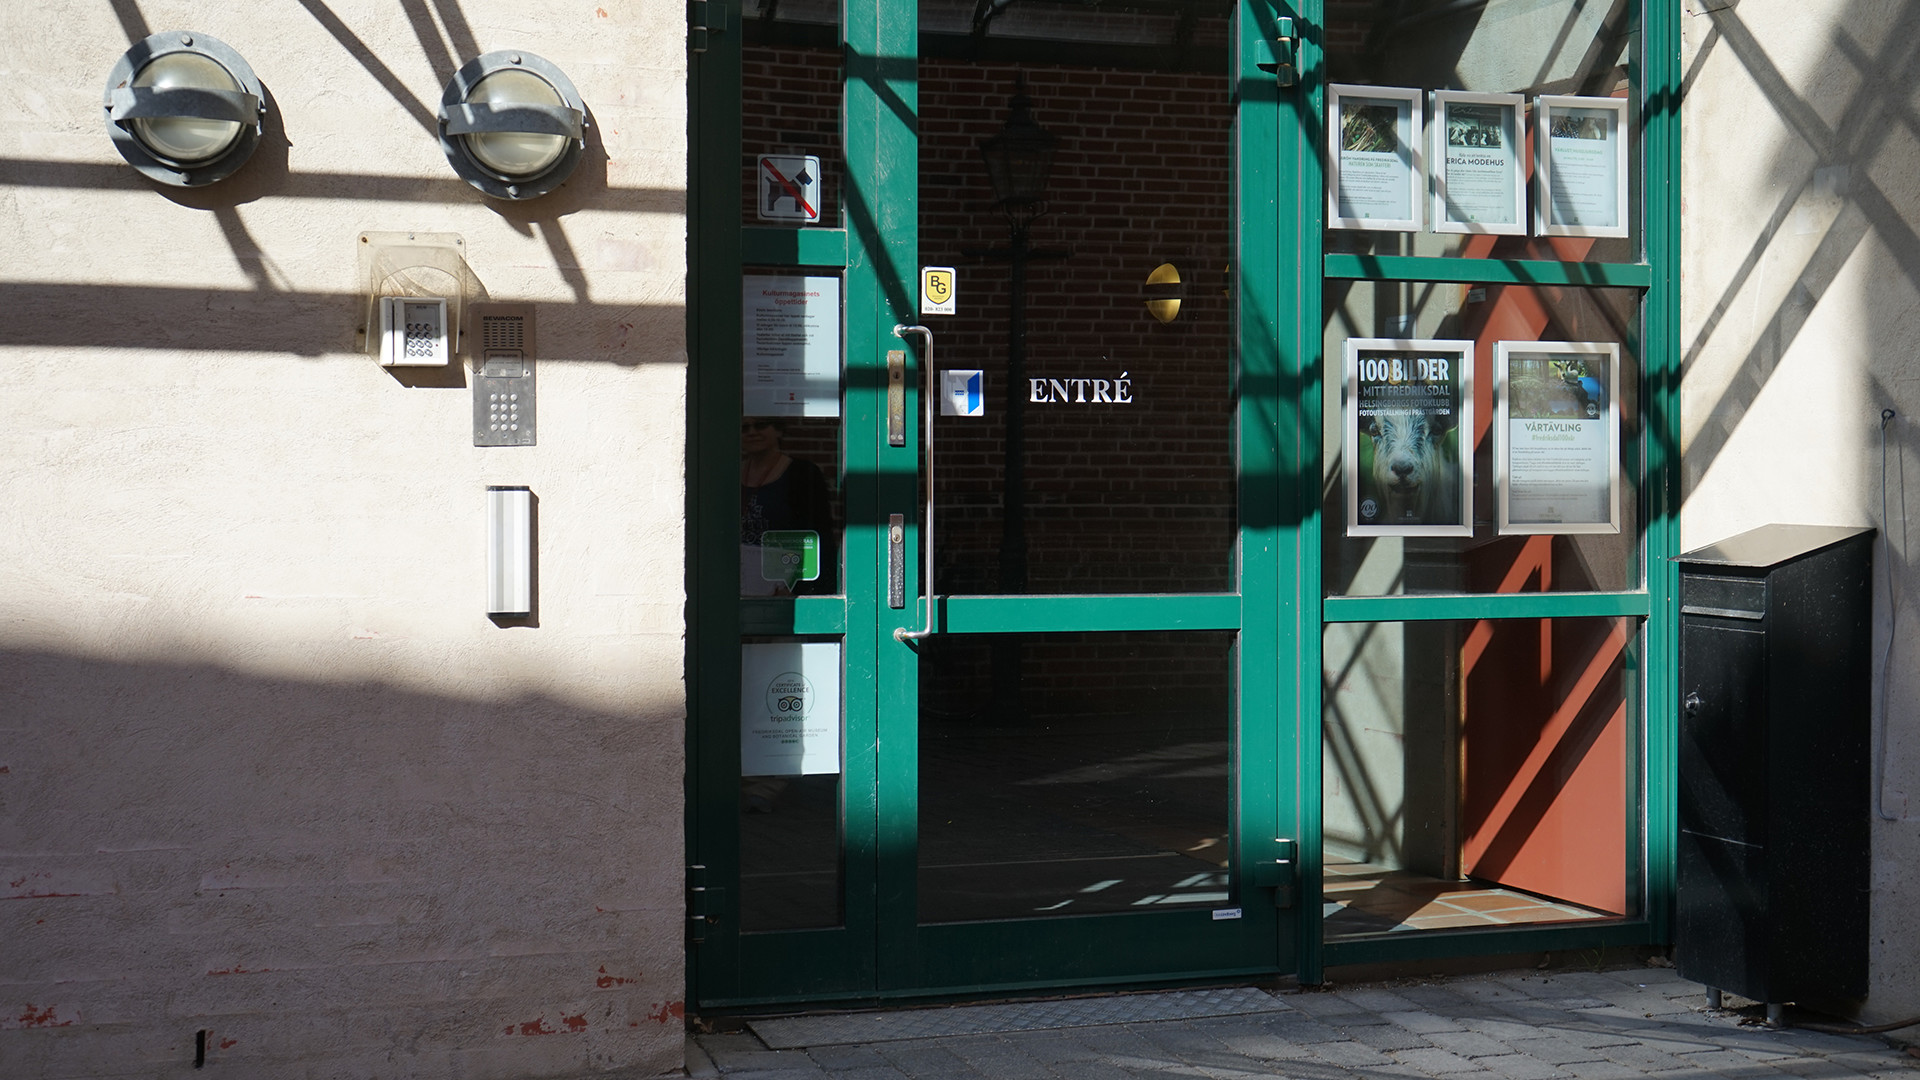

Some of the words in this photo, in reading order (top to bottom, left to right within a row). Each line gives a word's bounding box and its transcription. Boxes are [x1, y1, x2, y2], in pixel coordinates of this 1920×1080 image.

[1447, 157, 1467, 165] ERICA
[1468, 158, 1504, 166] MODEHUS
[931, 275, 946, 294] BG
[762, 290, 820, 298] Kulturmagasinets
[774, 298, 808, 306] öppettider
[1359, 358, 1389, 381] 100
[1392, 358, 1449, 381] BILDER
[1029, 371, 1133, 404] ENTRÉ
[1363, 386, 1386, 396] MITT
[1387, 385, 1450, 396] FREDRIKSDAL
[1359, 399, 1409, 408] HELSINGBORGS
[1410, 399, 1450, 407] FOTOKLUBB
[1525, 421, 1582, 432] VÅRTÄVLING
[770, 714, 808, 723] tripadvisor
